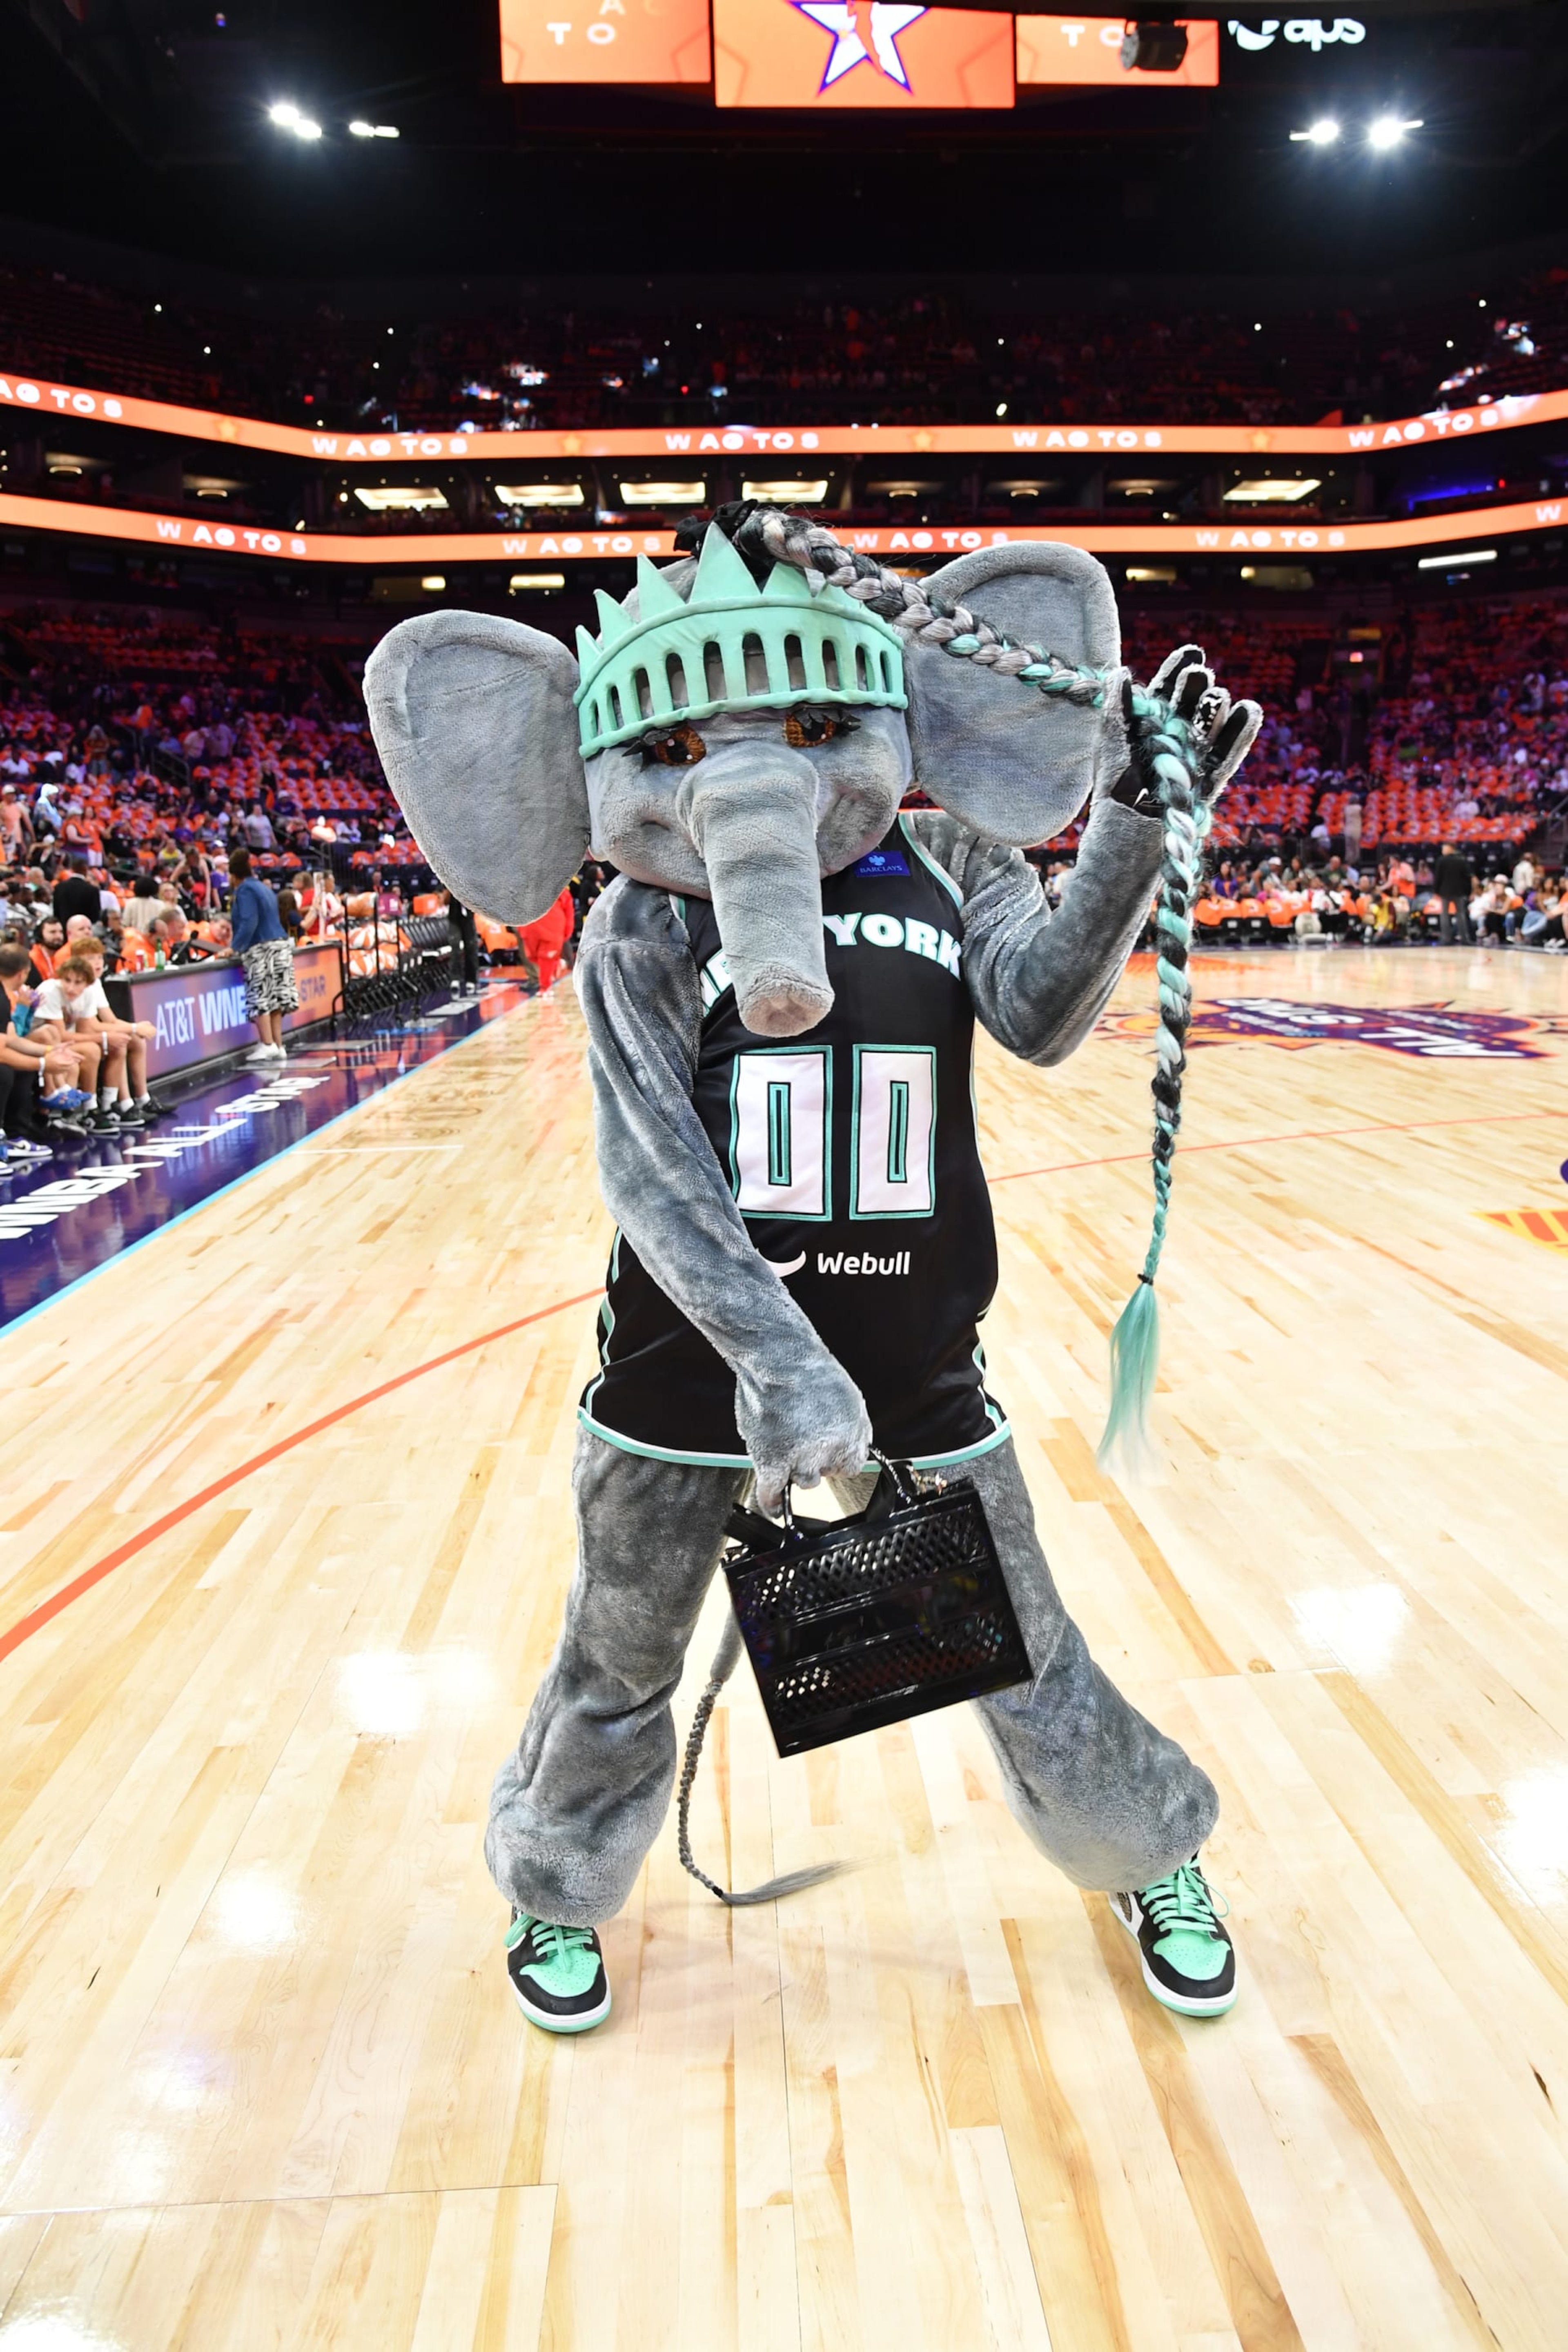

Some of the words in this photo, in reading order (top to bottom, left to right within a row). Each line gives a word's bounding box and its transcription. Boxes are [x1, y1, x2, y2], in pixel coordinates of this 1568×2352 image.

[860, 865, 903, 873] BARCLAYS
[822, 912, 962, 981] YORK
[155, 996, 196, 1051] AT&T
[729, 1044, 937, 1222] 00
[817, 1251, 911, 1275] Webull
